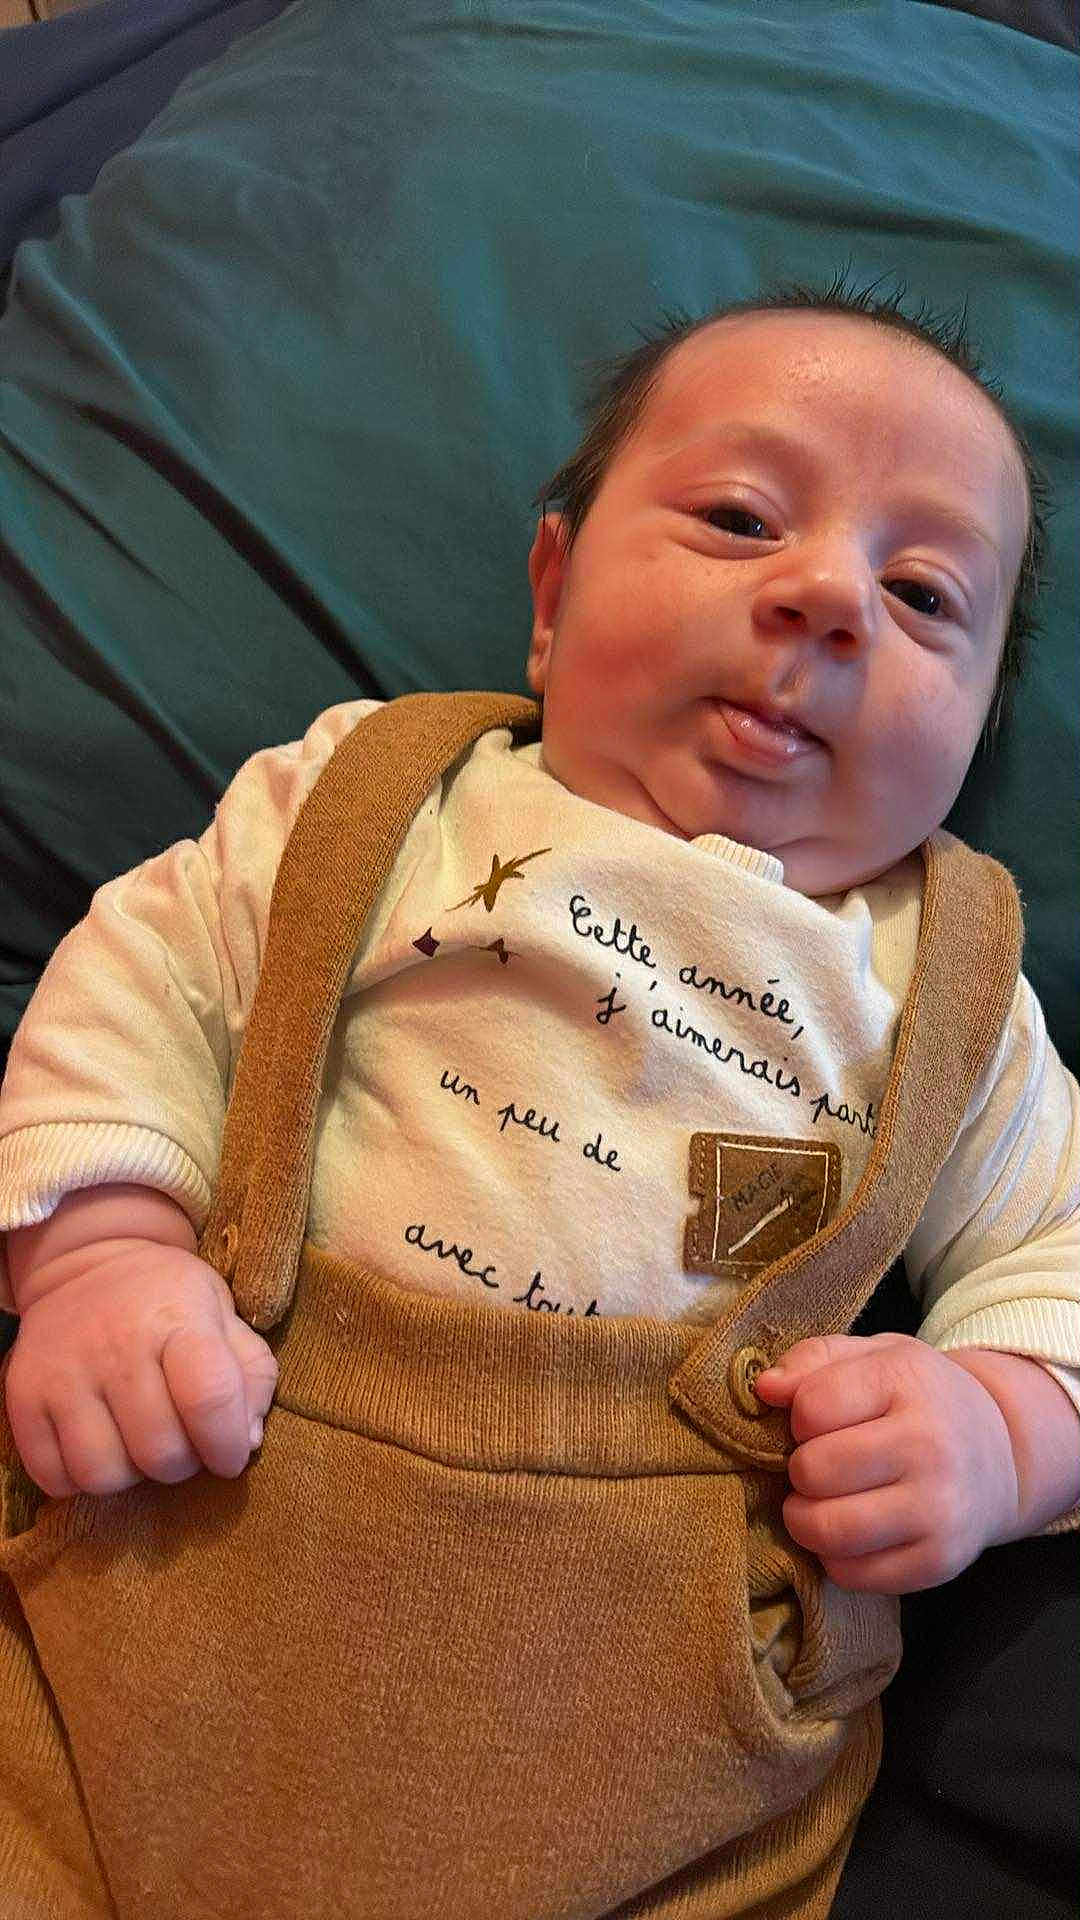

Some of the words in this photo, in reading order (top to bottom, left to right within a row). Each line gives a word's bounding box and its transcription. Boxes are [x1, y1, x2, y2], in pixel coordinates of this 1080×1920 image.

[569, 895, 656, 968] Cette
[679, 965, 804, 1040] année,
[440, 1070, 480, 1105] un
[497, 1103, 560, 1143] peu
[582, 1133, 621, 1171] de
[404, 1224, 499, 1287] avec
